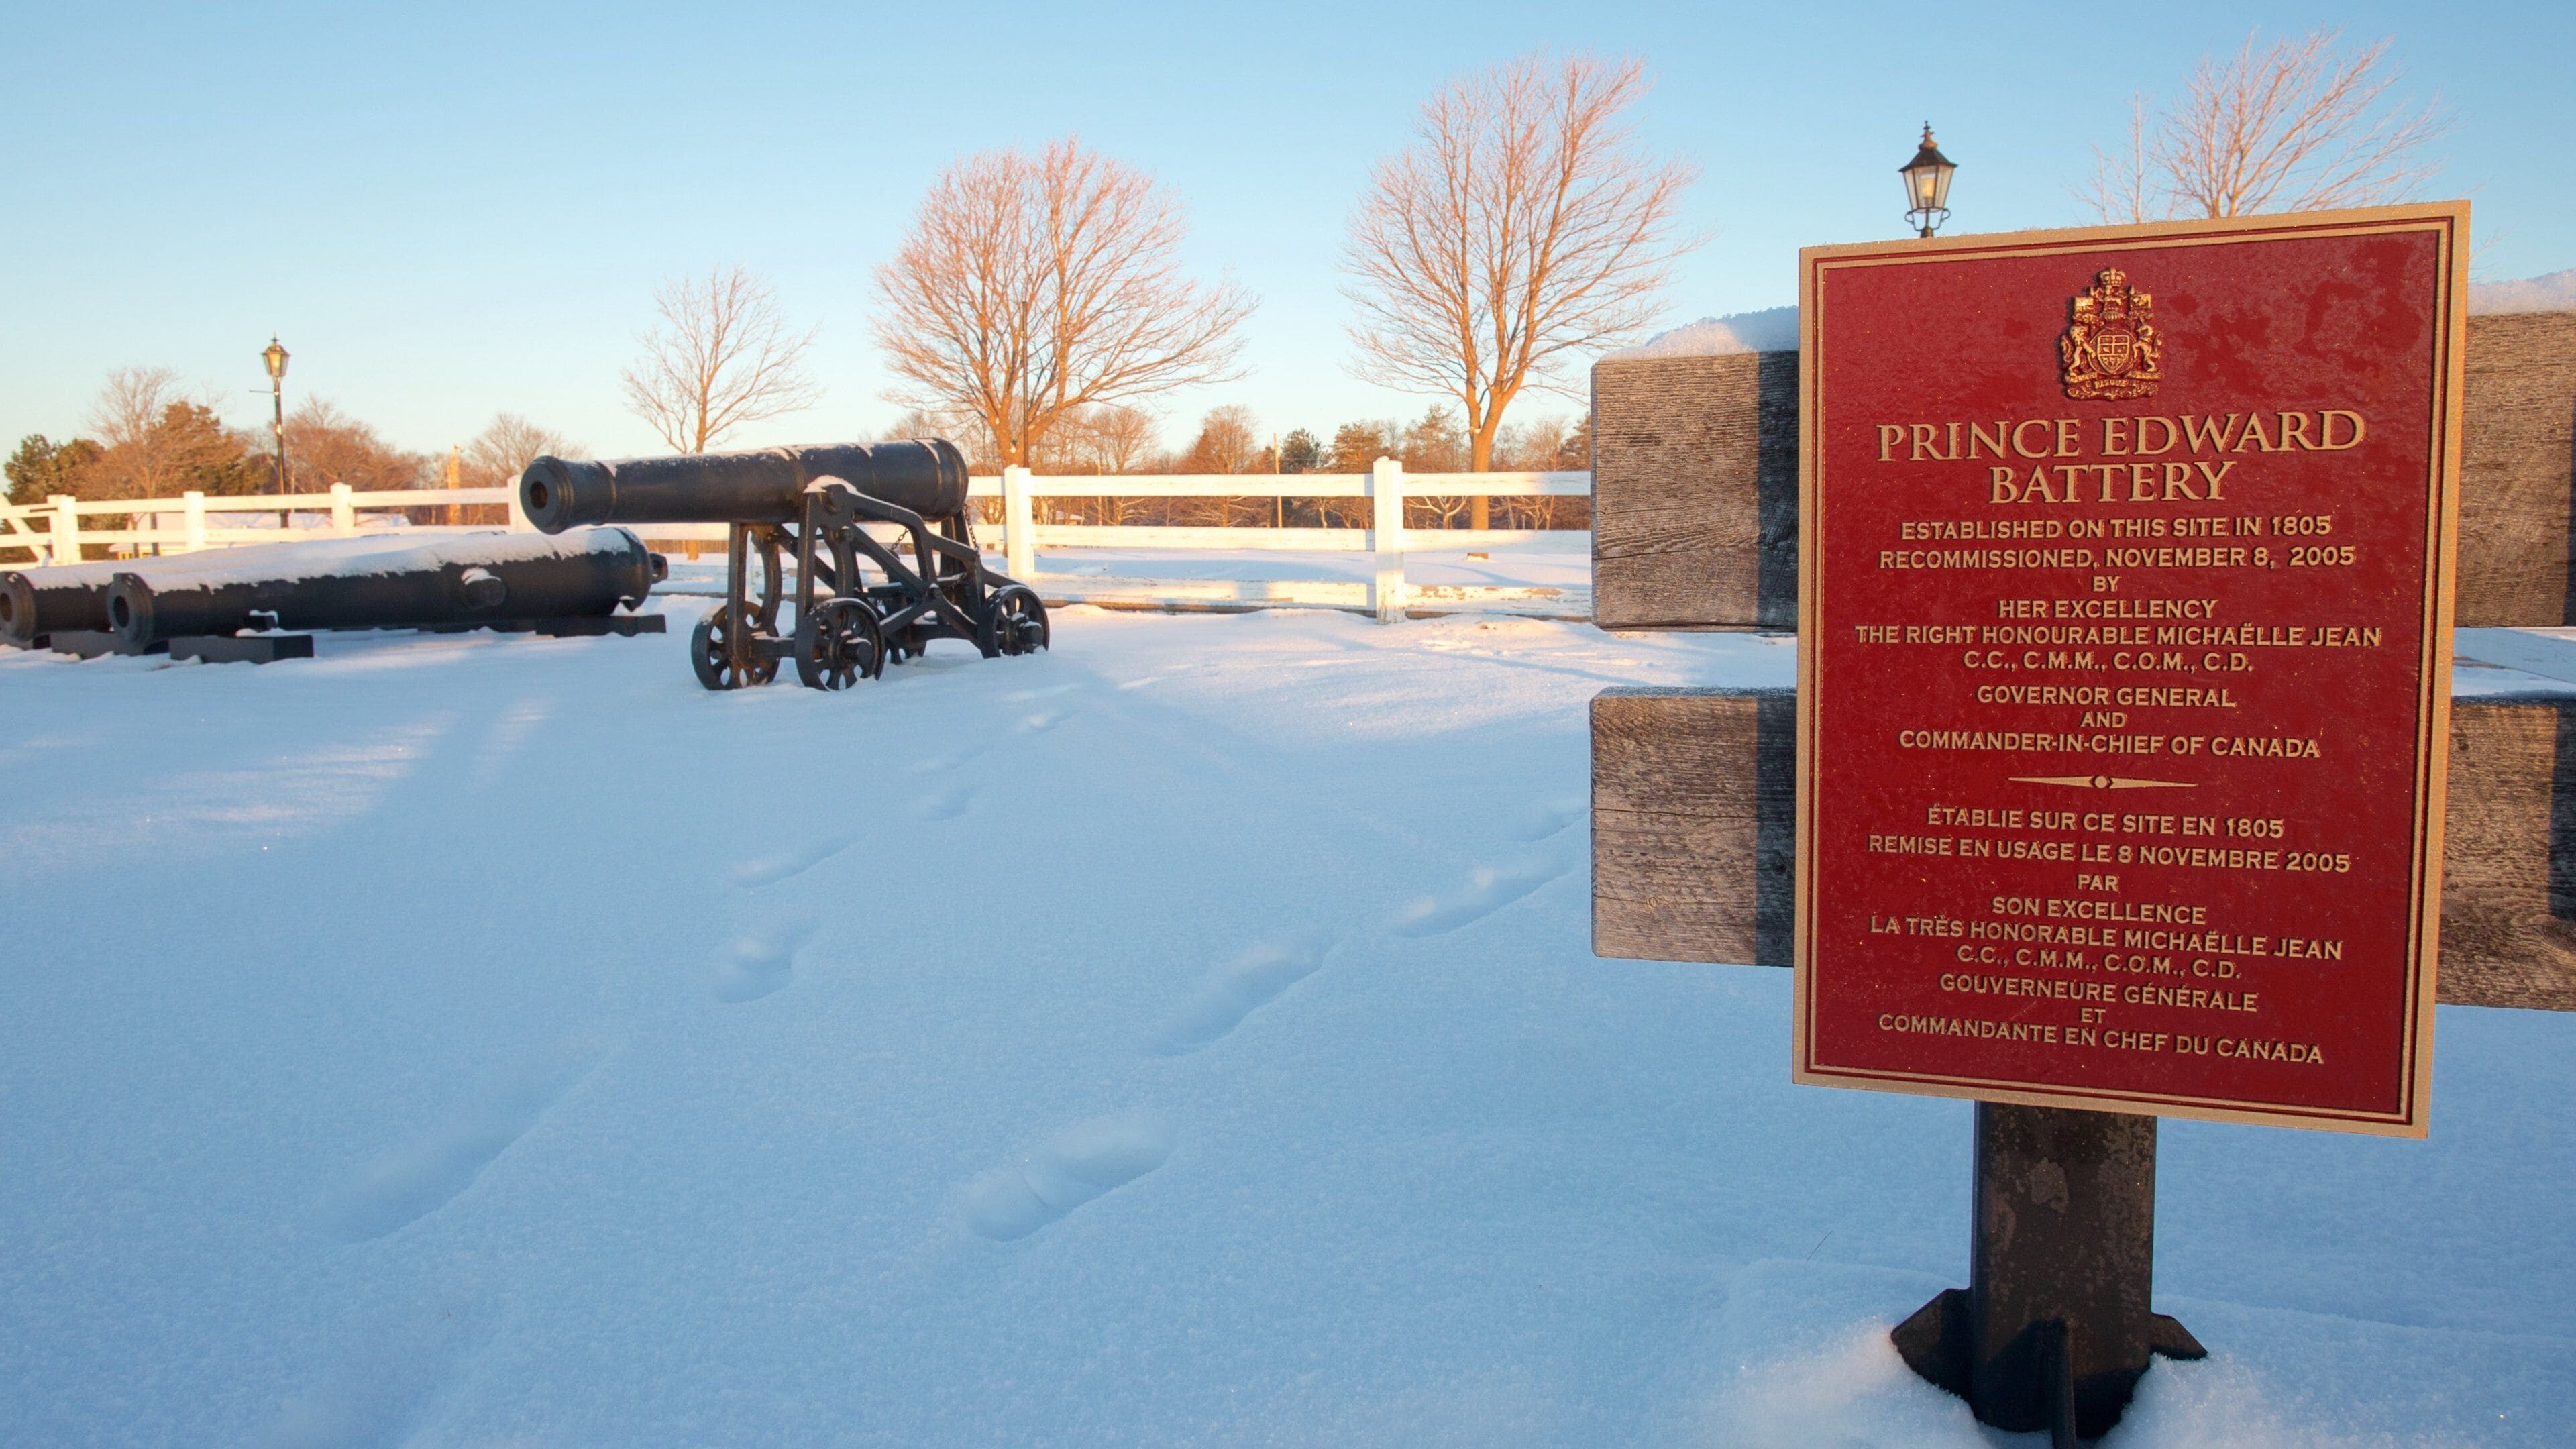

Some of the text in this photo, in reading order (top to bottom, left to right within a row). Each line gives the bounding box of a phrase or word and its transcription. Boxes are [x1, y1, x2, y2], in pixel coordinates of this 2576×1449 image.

[1876, 409, 2367, 462] PRINCE EDWARD
[1989, 460, 2238, 504] BATTERY
[1902, 515, 2332, 540] ESTABLISHED ON THIS SITE IN 1805
[1880, 545, 2357, 570] RECOMMISSIONED, NOVEMBER 8, 2005
[2093, 576, 2121, 592] BY
[1999, 599, 2218, 619] HER EXCELLENCY
[1855, 622, 2382, 647] THE RIGHT HONOURABLE MICHAËLLE JEAN
[1964, 650, 2253, 674] C.C., C.M.M., C.O.M., C.D.
[1977, 685, 2237, 708] GOVERNOR GENERAL
[2080, 711, 2128, 728] AND
[1899, 730, 2321, 758] COMMANDER-IN-CHIEF OF CANADA
[1928, 804, 2284, 839] ÉTABLIE SUR CE SITE EN 1805
[1870, 835, 2351, 873] REMISE EN USAGE LE 8 NOVEMBRE 2005
[2078, 874, 2118, 892] PAR
[1992, 896, 2206, 925] SON EXCELLENCE
[1871, 916, 1900, 934] LA
[1970, 922, 2116, 947] HONORABLE
[2125, 930, 2267, 956] MICHAËLLE
[2273, 938, 2343, 960] JEAN
[1957, 945, 2240, 979] C.C., C.M.M., C.O.M., C.D.
[1940, 973, 2258, 1012] GOUVERNEURE GÉNÉRALE
[2081, 1008, 2106, 1024] ET
[1879, 1014, 2324, 1065] COMMANDANTE EN CHEF DU CANADA
